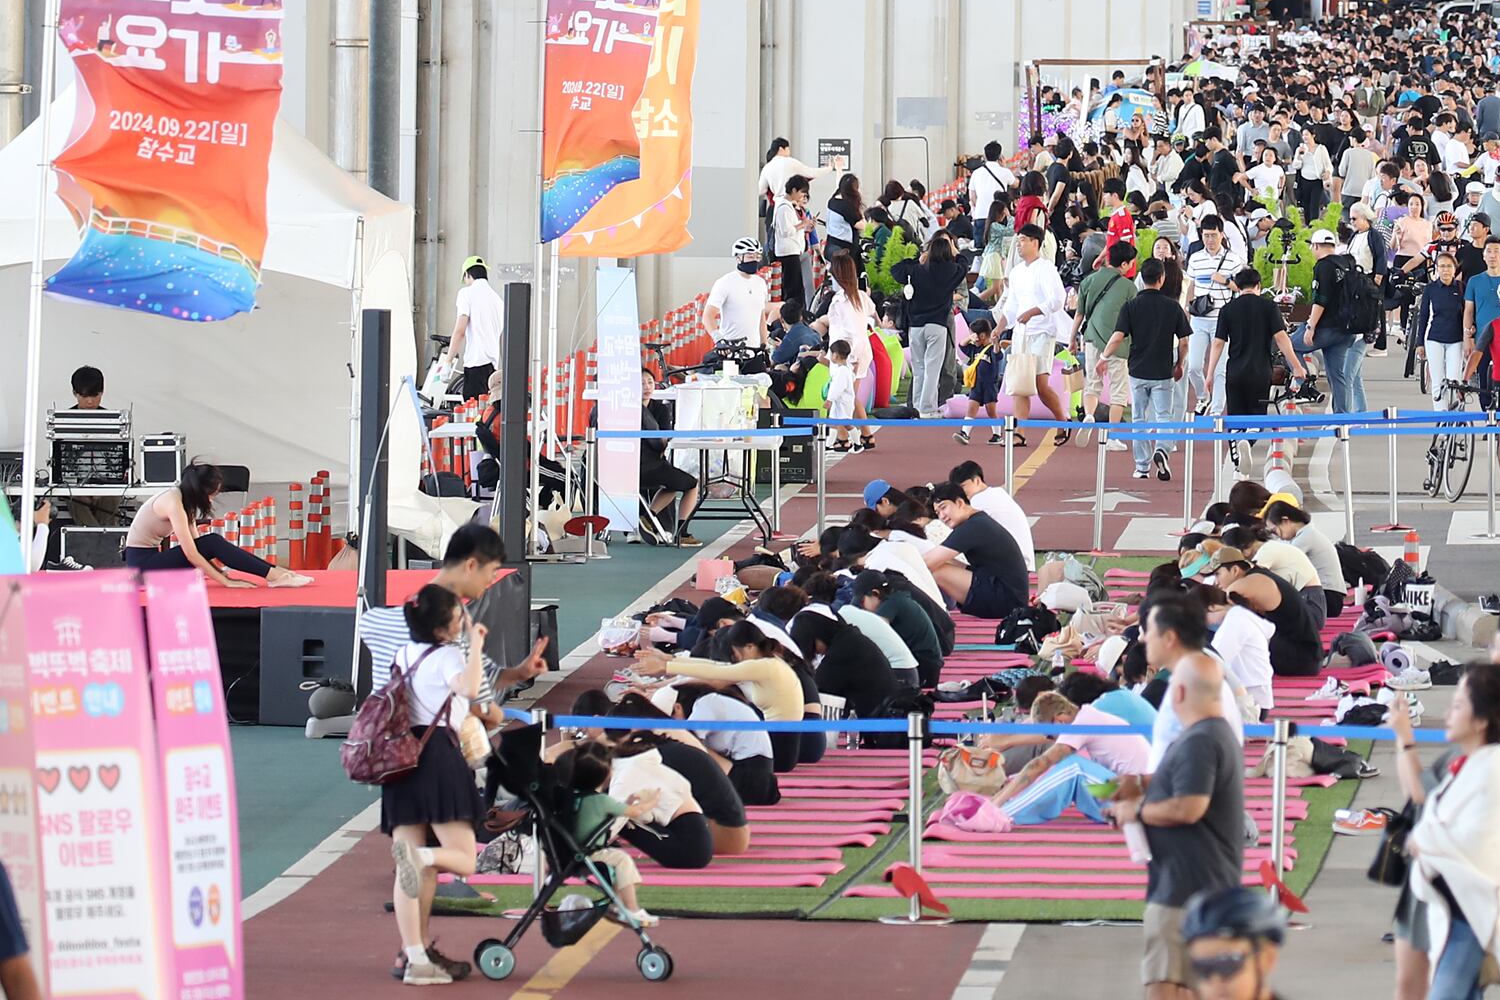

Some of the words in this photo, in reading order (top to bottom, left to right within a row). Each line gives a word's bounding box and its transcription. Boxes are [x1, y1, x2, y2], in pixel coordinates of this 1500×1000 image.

[573, 10, 619, 55] 요가
[115, 14, 221, 84] 요가
[109, 110, 249, 147] 2024.09.22[일]
[136, 137, 197, 166] 잠수교
[1402, 590, 1430, 606] NIKE
[91, 648, 134, 675] 축제
[79, 808, 133, 836] 팔로우
[58, 840, 114, 868] 이벤트
